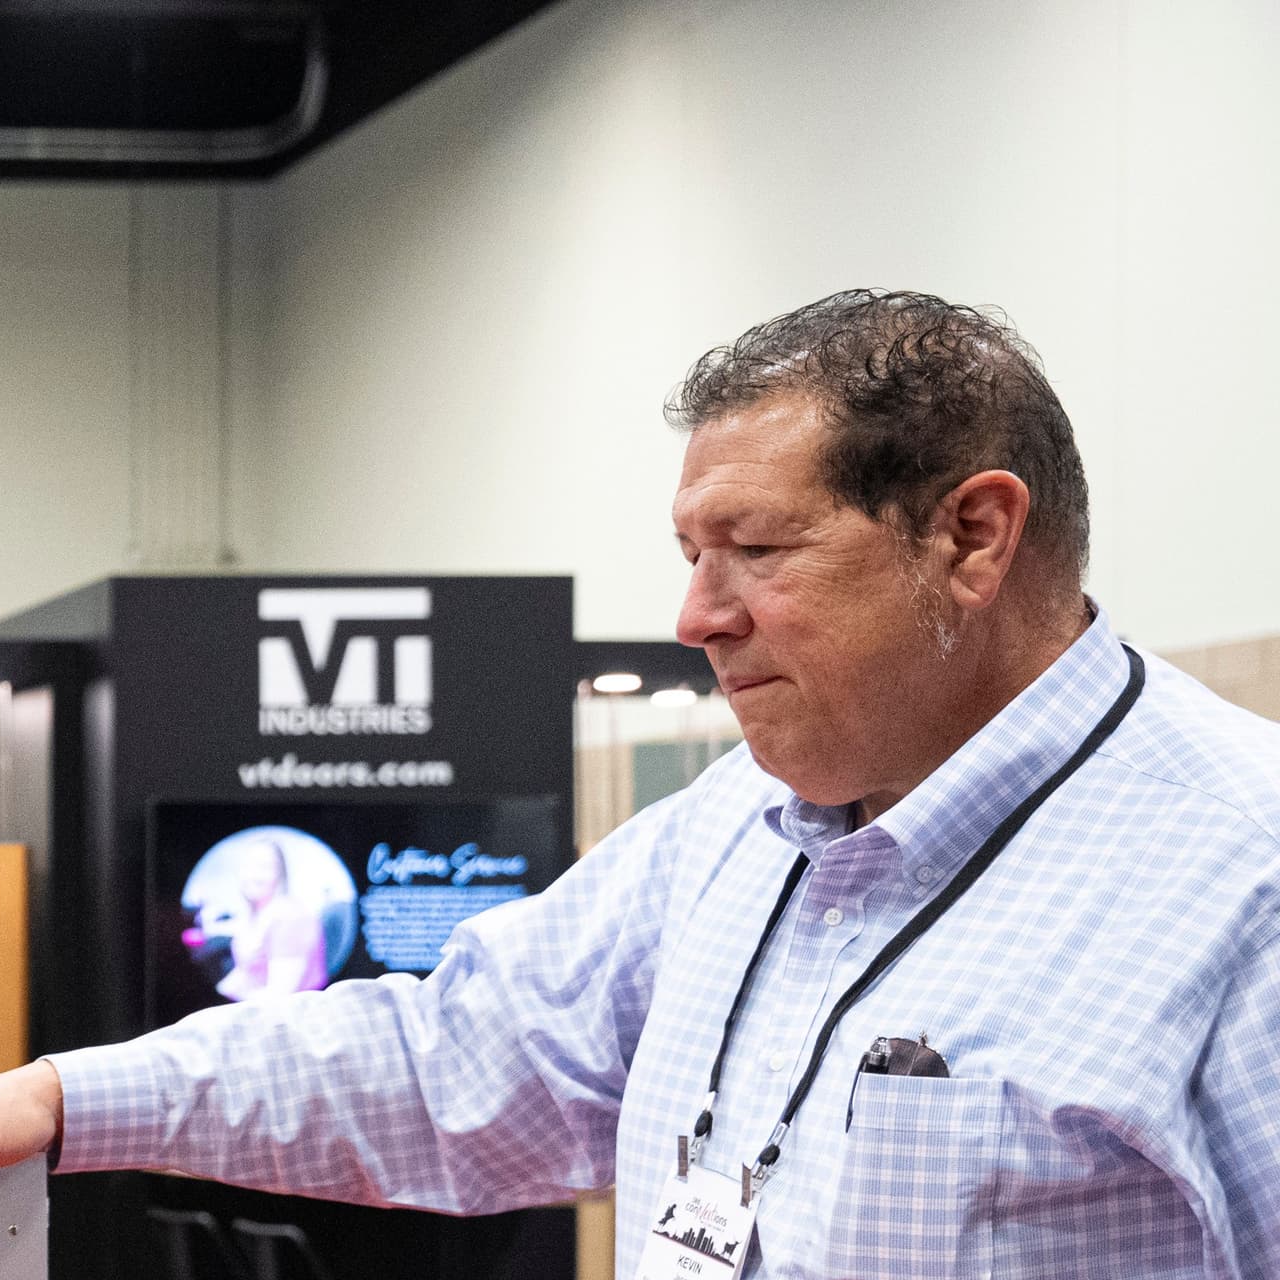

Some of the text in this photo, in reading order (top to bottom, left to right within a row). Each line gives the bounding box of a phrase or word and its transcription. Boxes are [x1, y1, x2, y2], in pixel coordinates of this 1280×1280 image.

[257, 587, 432, 708] VT
[258, 707, 432, 736] INDUSTRIES
[239, 752, 453, 788] vtdoors.com
[677, 1255, 703, 1275] KEVIN
